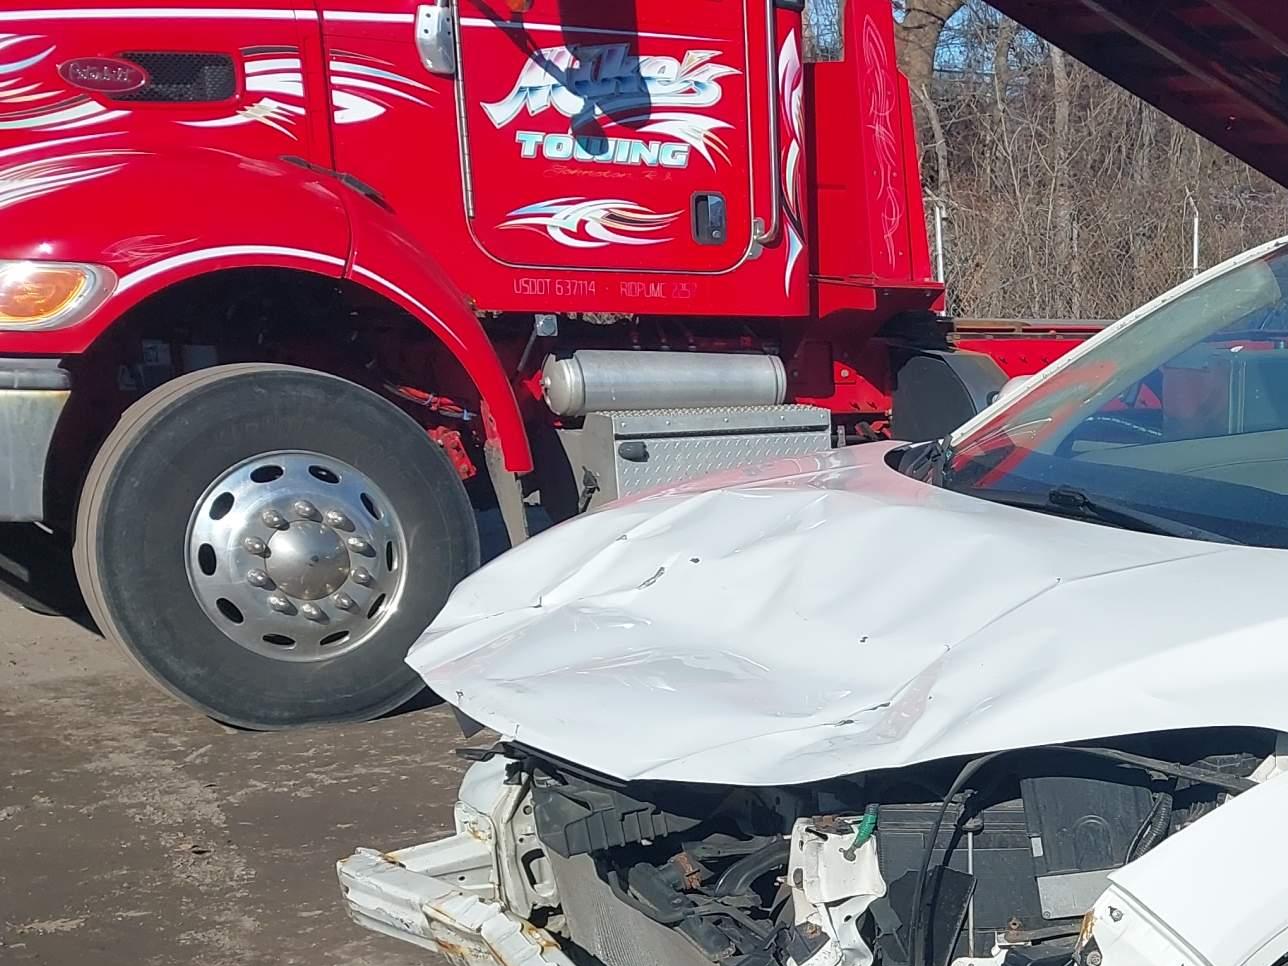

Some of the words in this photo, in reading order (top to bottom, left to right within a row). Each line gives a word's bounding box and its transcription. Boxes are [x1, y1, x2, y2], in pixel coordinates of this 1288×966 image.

[515, 130, 691, 168] TOWING
[513, 278, 551, 295] USDOT
[555, 280, 596, 296] 637114
